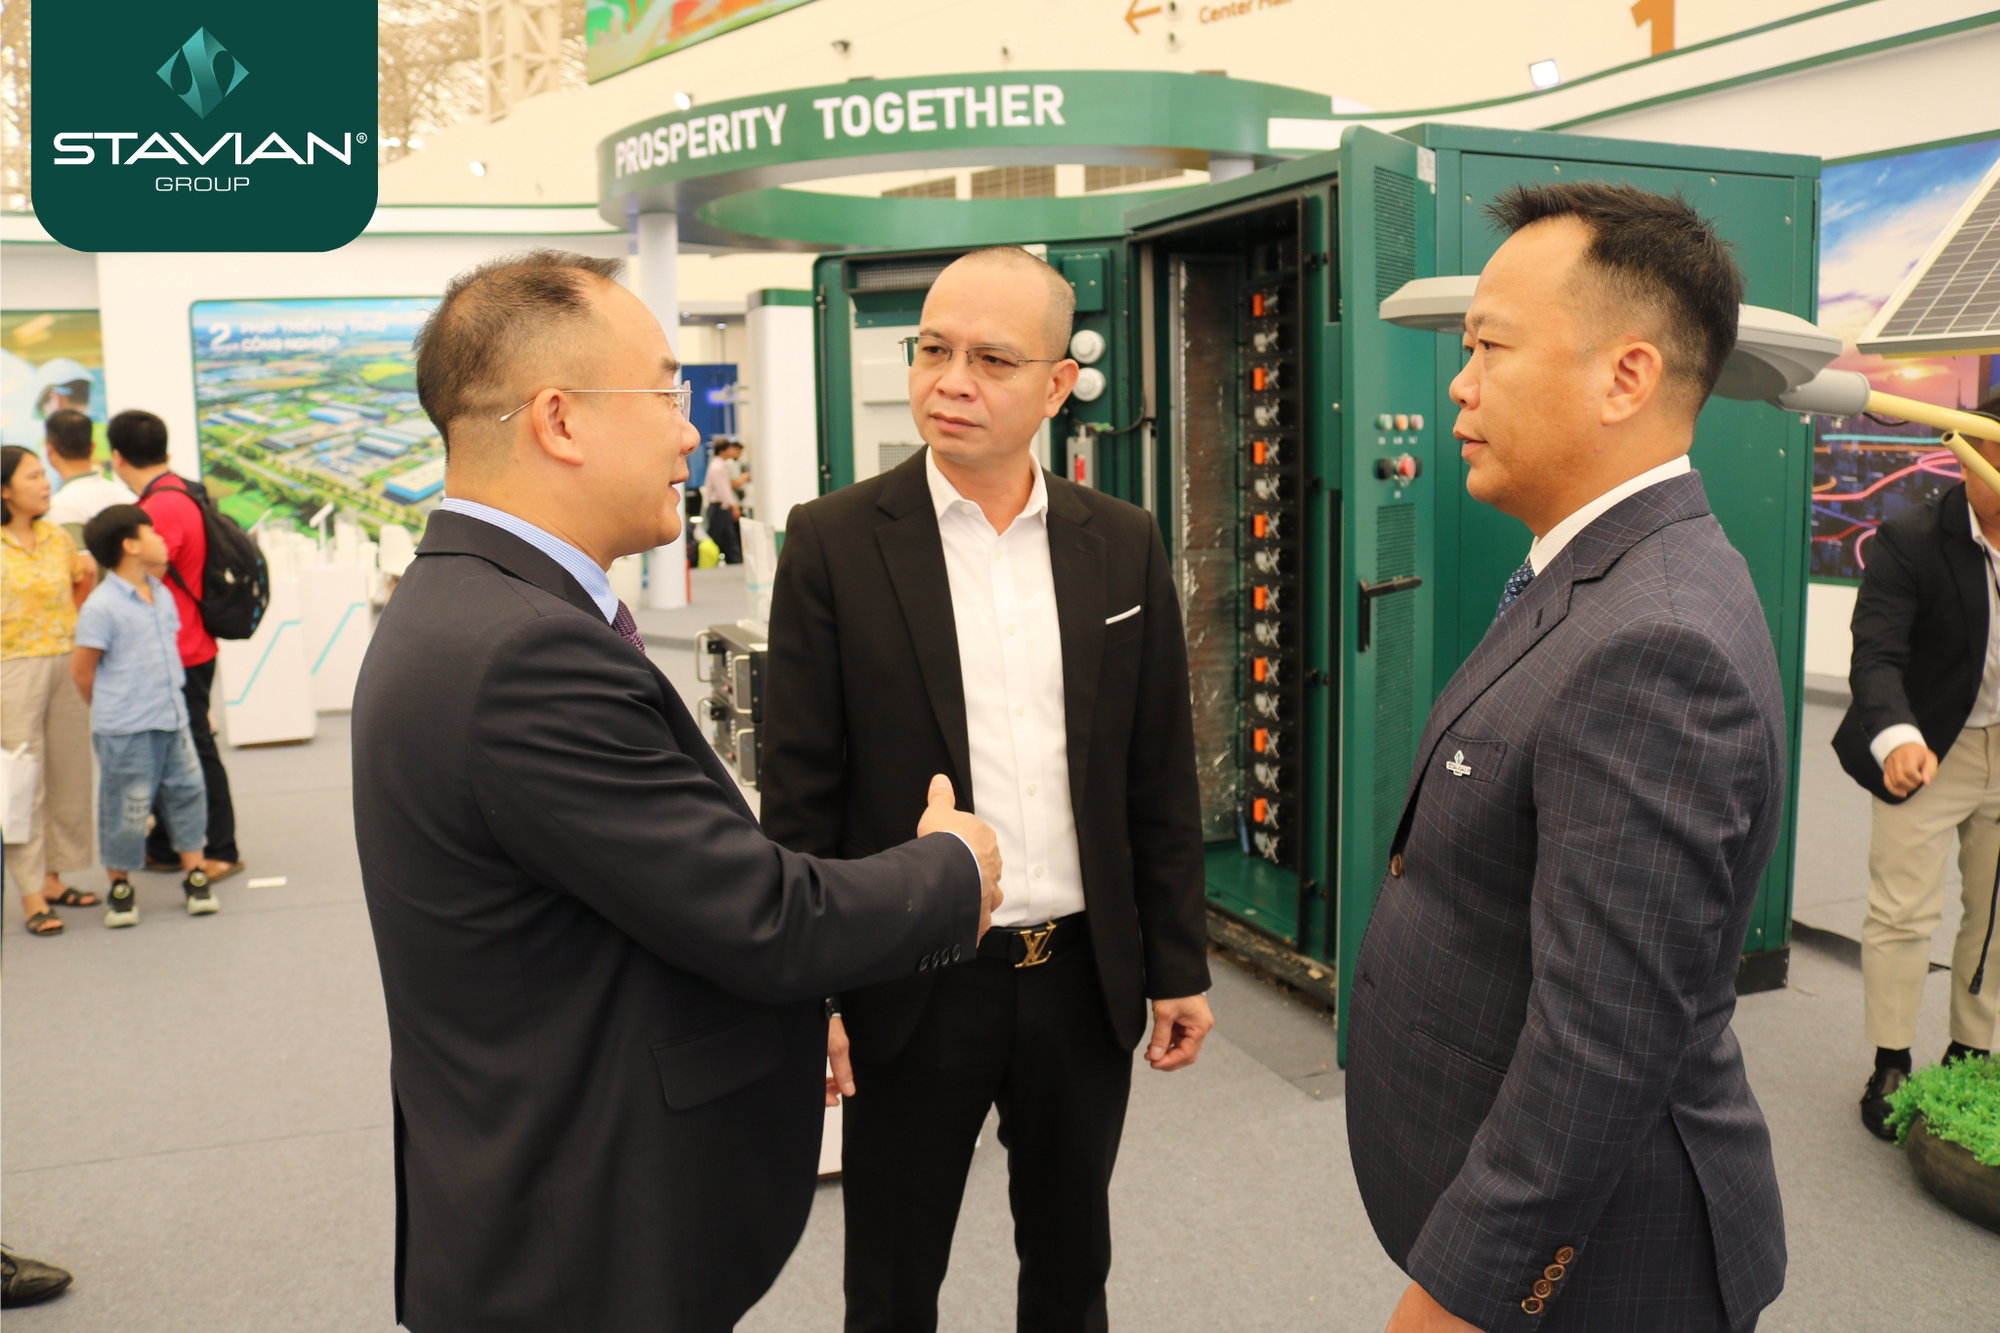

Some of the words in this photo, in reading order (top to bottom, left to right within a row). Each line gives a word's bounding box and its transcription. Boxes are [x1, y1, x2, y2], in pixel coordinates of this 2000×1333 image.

[1199, 0, 1252, 24] Center
[1630, 0, 1675, 56] 1
[615, 103, 788, 179] PROSPERITY
[813, 84, 1066, 140] TOGETHER
[209, 322, 231, 351] 2
